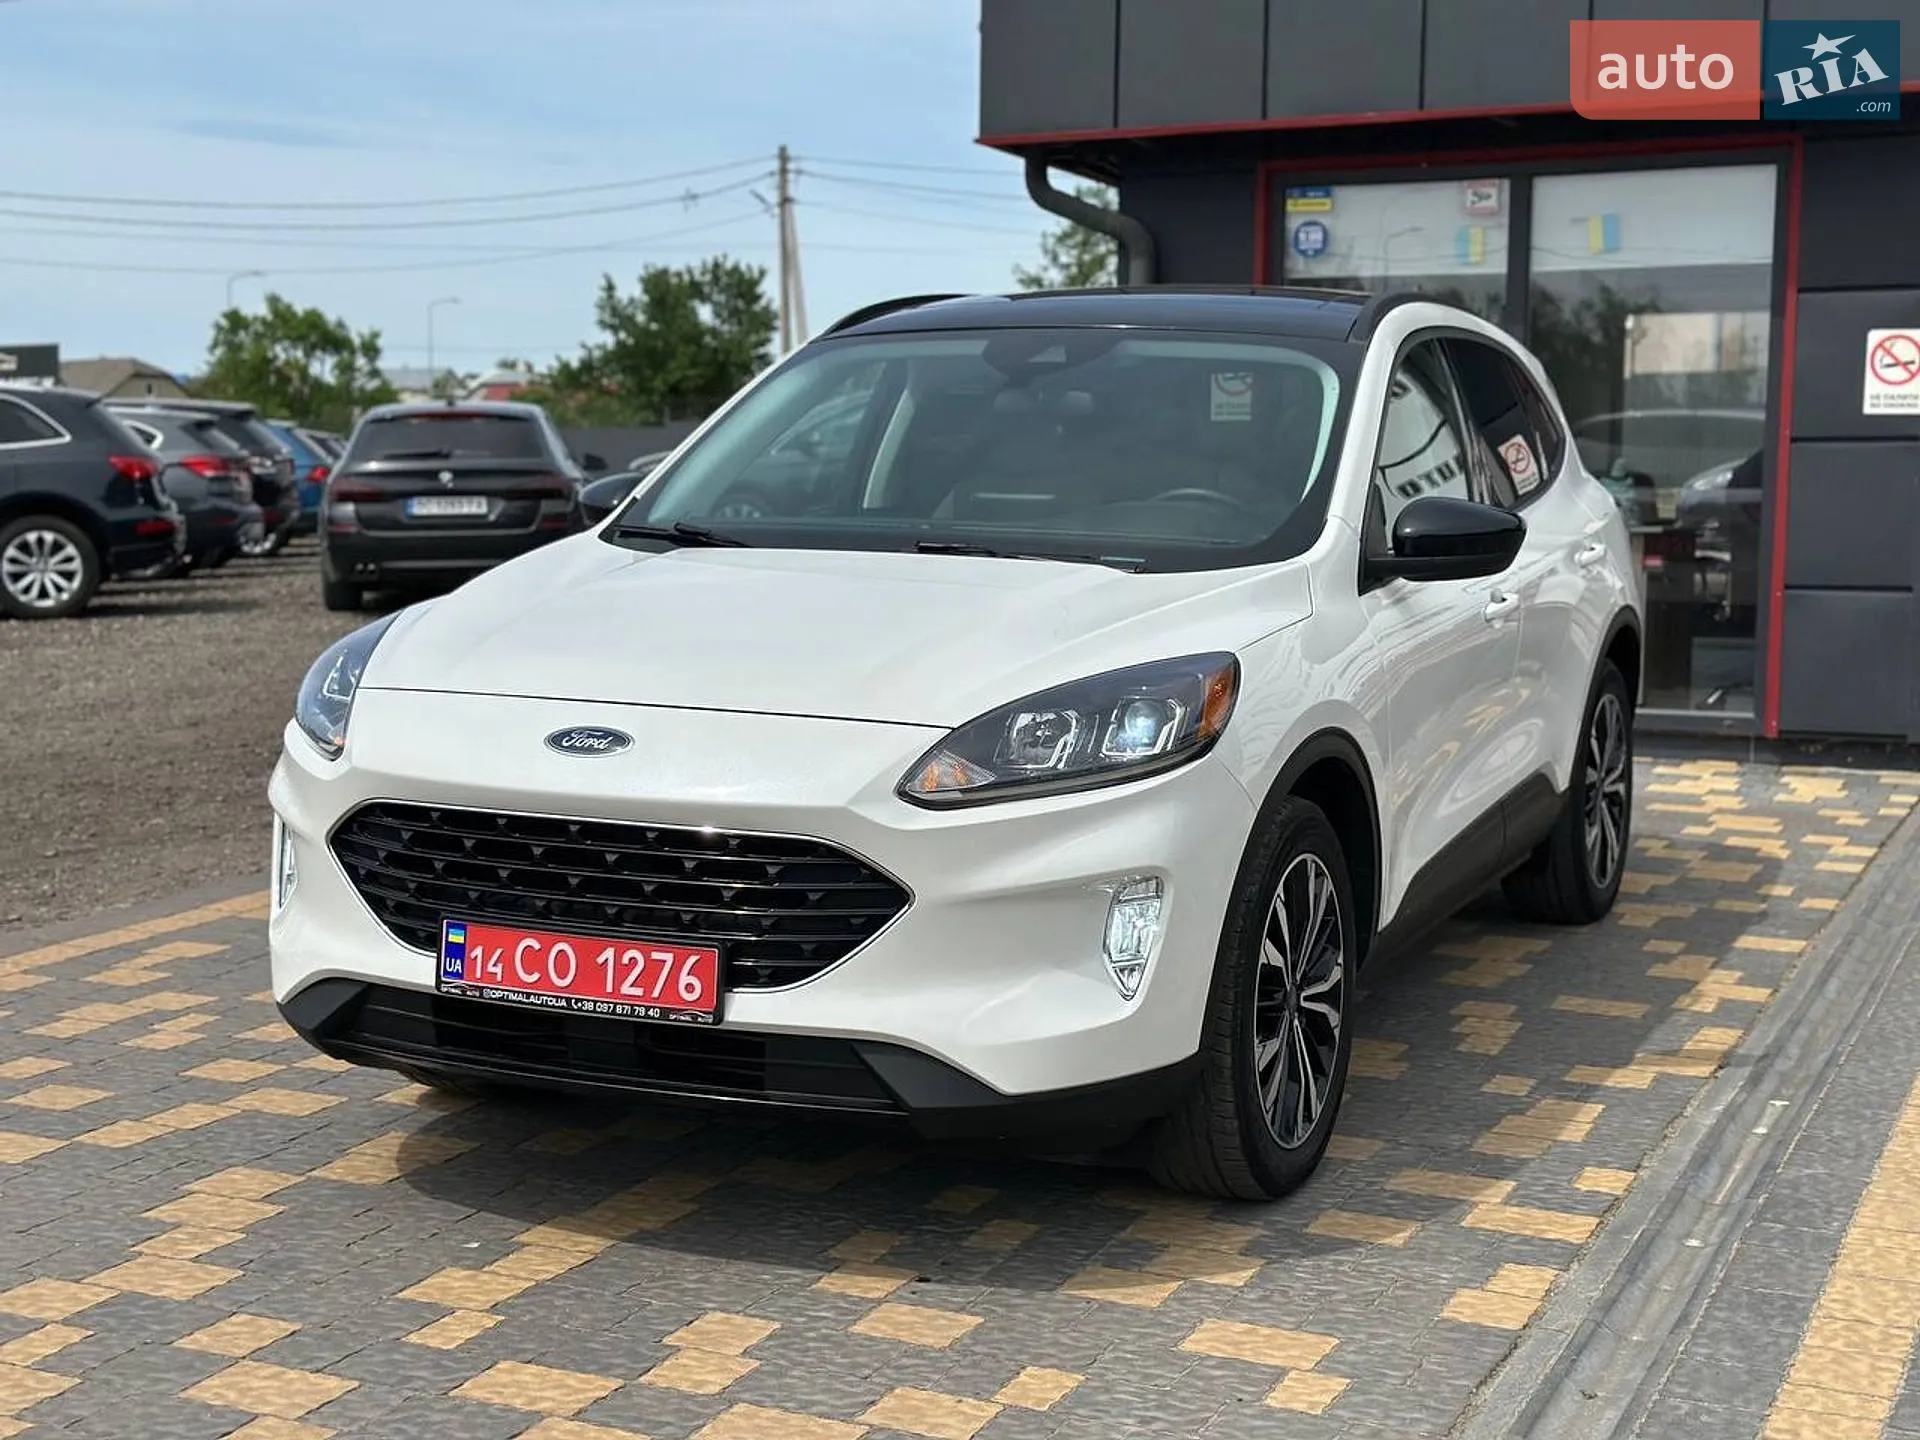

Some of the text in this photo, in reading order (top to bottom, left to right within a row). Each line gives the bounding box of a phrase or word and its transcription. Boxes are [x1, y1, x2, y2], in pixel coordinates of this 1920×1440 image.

[562, 730, 614, 750] Ford
[445, 957, 462, 973] UA
[470, 937, 702, 1002] 14 CO 1276
[577, 1000, 594, 1011] +38
[616, 1004, 631, 1016] 871
[647, 1007, 661, 1018] 40
